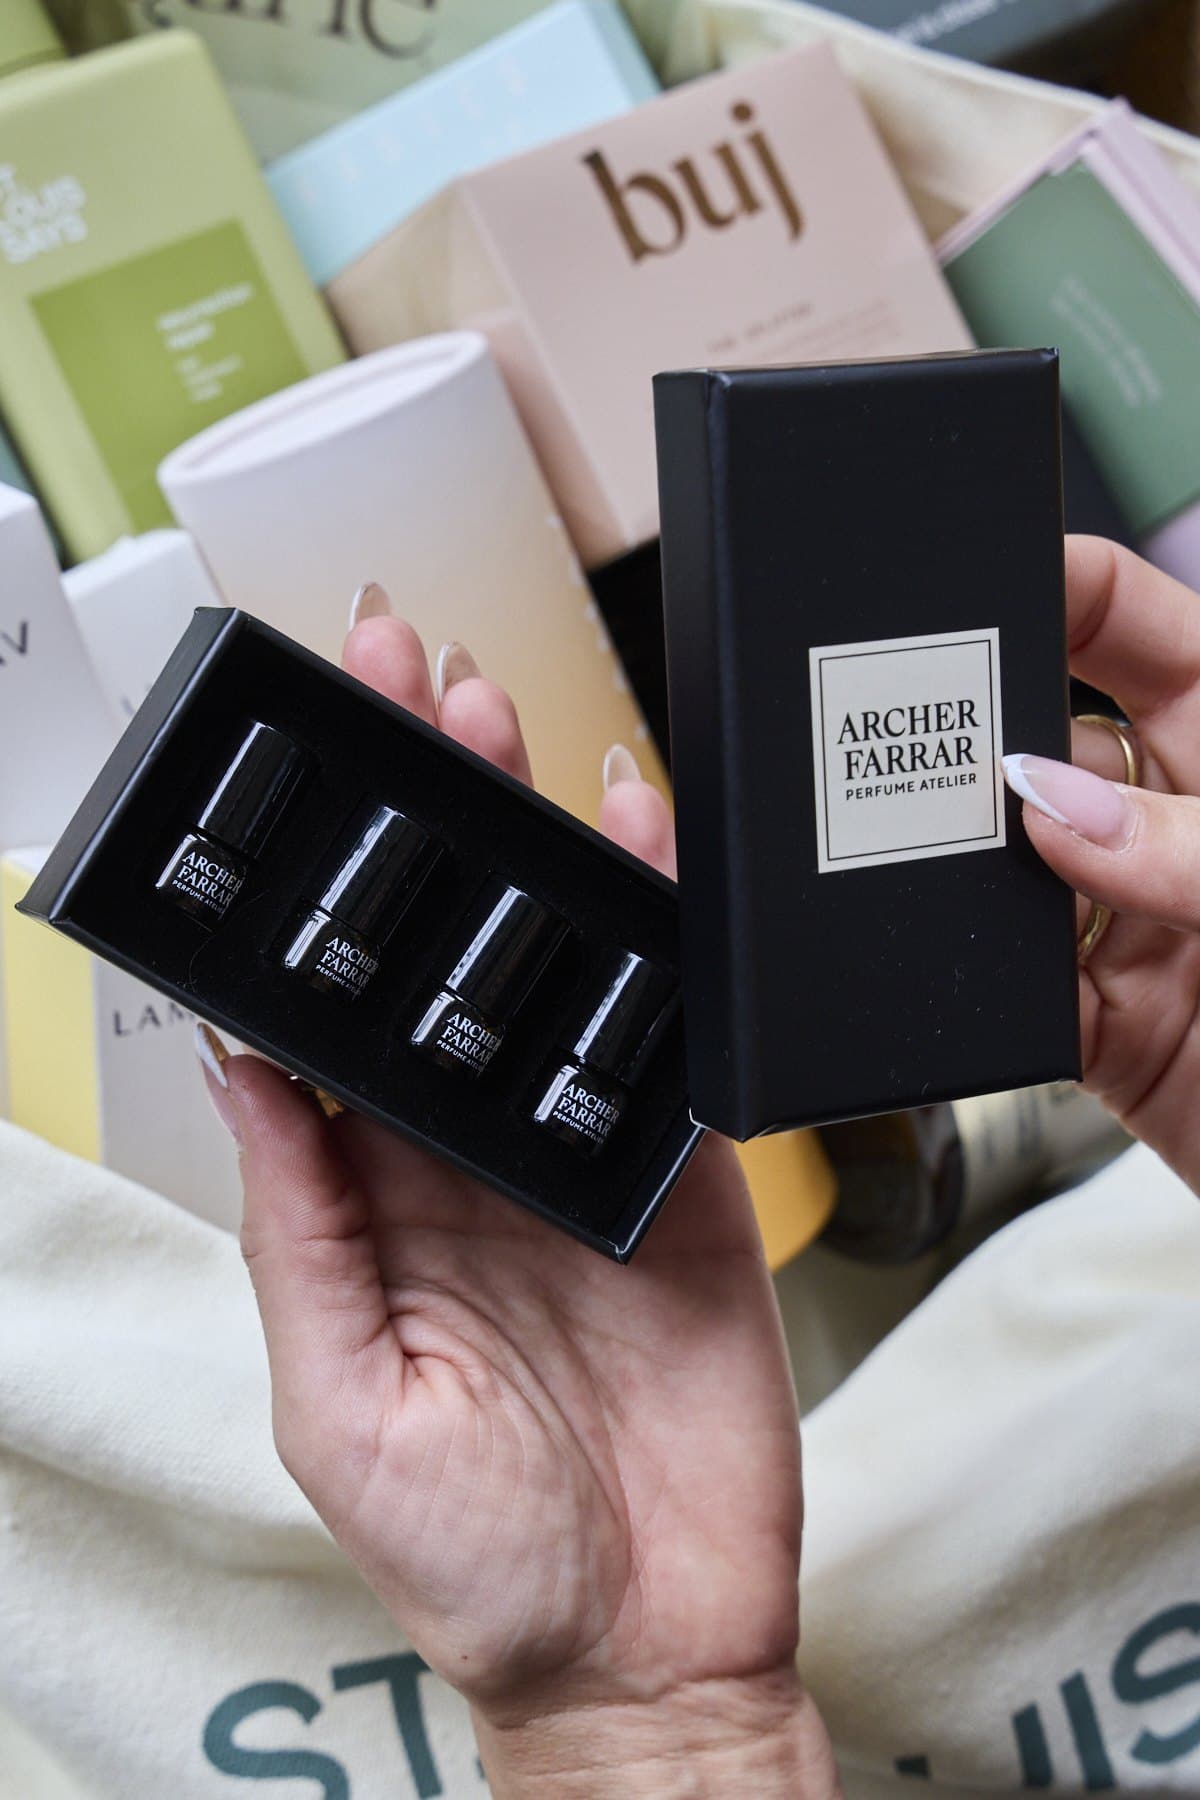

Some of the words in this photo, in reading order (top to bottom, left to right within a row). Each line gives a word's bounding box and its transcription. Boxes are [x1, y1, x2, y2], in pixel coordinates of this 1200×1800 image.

[580, 101, 805, 266] buj
[837, 699, 980, 744] ARCHER
[844, 736, 978, 780] FARRAR
[846, 781, 915, 800] PERFUME
[919, 773, 977, 790] ATELIER
[172, 879, 206, 902] PERFUME
[177, 865, 235, 906] FARRAR
[182, 851, 243, 894] ARCHER
[315, 964, 346, 986] PERFUME
[320, 949, 371, 989] FARRAR
[325, 937, 379, 975] ARCHER
[436, 1039, 467, 1061] PERFUME
[552, 1110, 585, 1133] PERFUME
[557, 1096, 611, 1137] FARRAR
[562, 1083, 620, 1124] ARCHER
